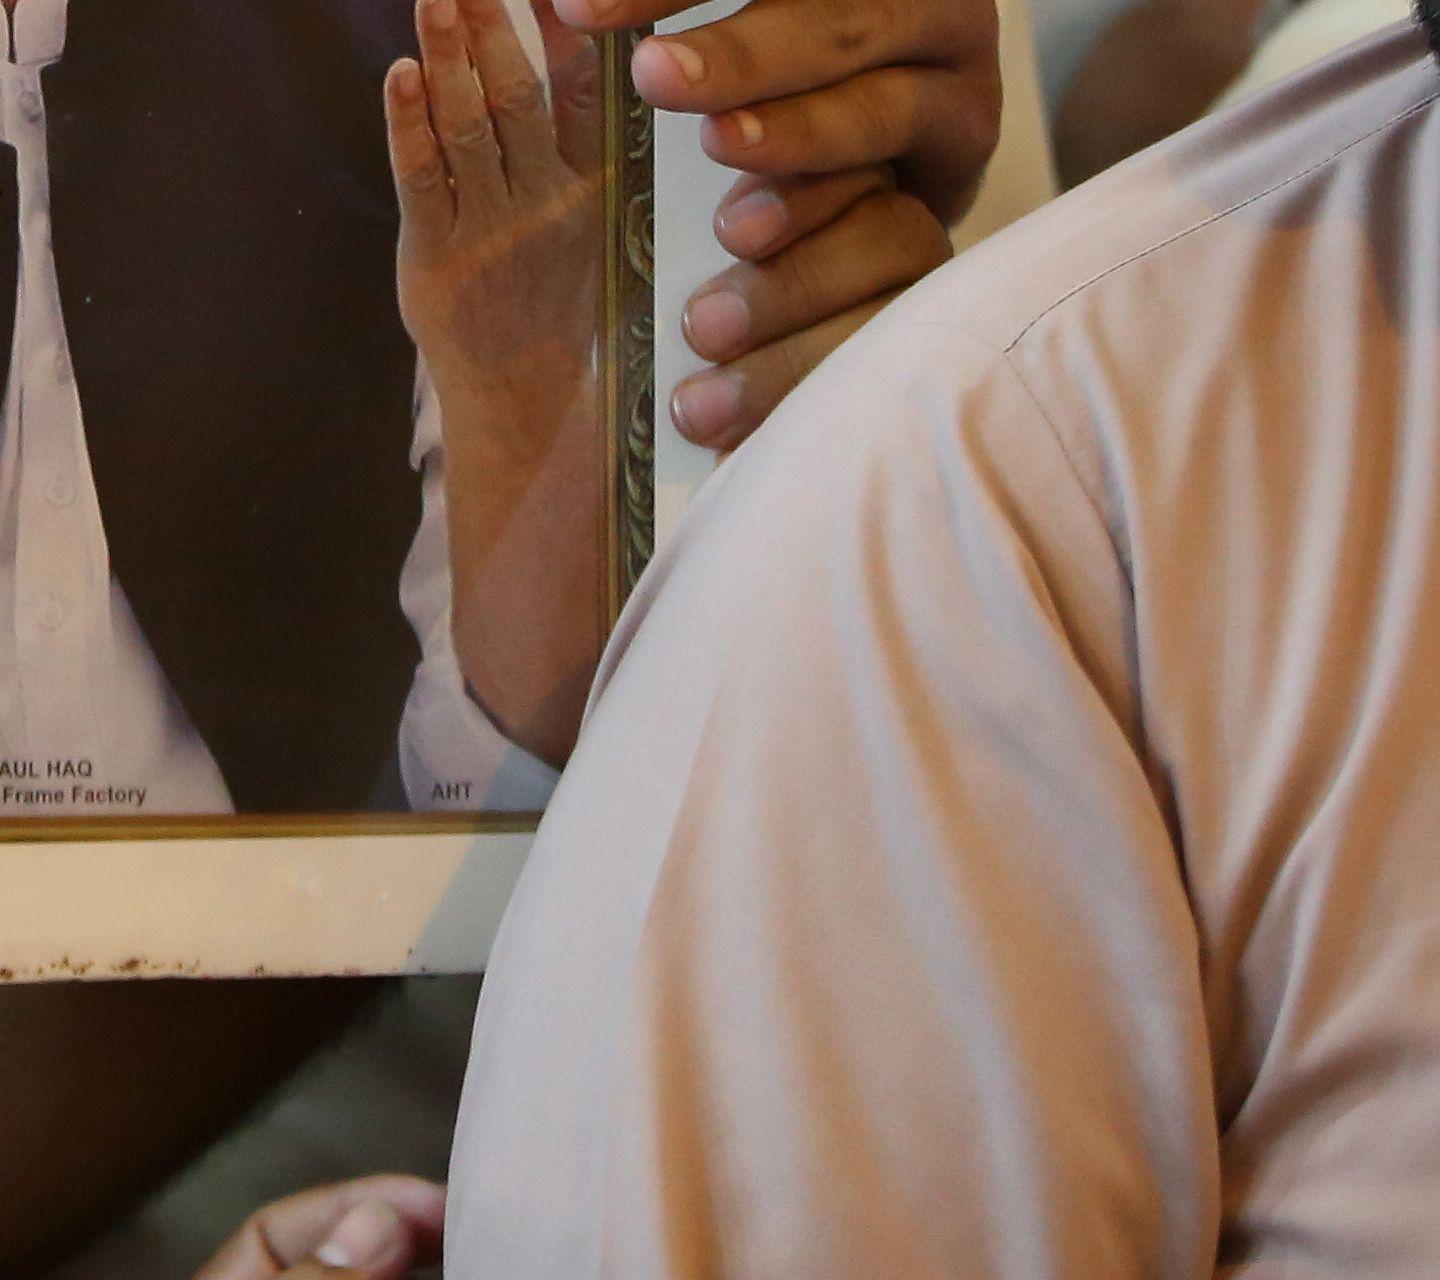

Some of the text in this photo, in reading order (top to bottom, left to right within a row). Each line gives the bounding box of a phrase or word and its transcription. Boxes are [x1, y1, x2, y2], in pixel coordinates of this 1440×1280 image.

[47, 759, 94, 779] HAQ
[2, 785, 65, 804] Frame
[71, 784, 148, 807] Factory
